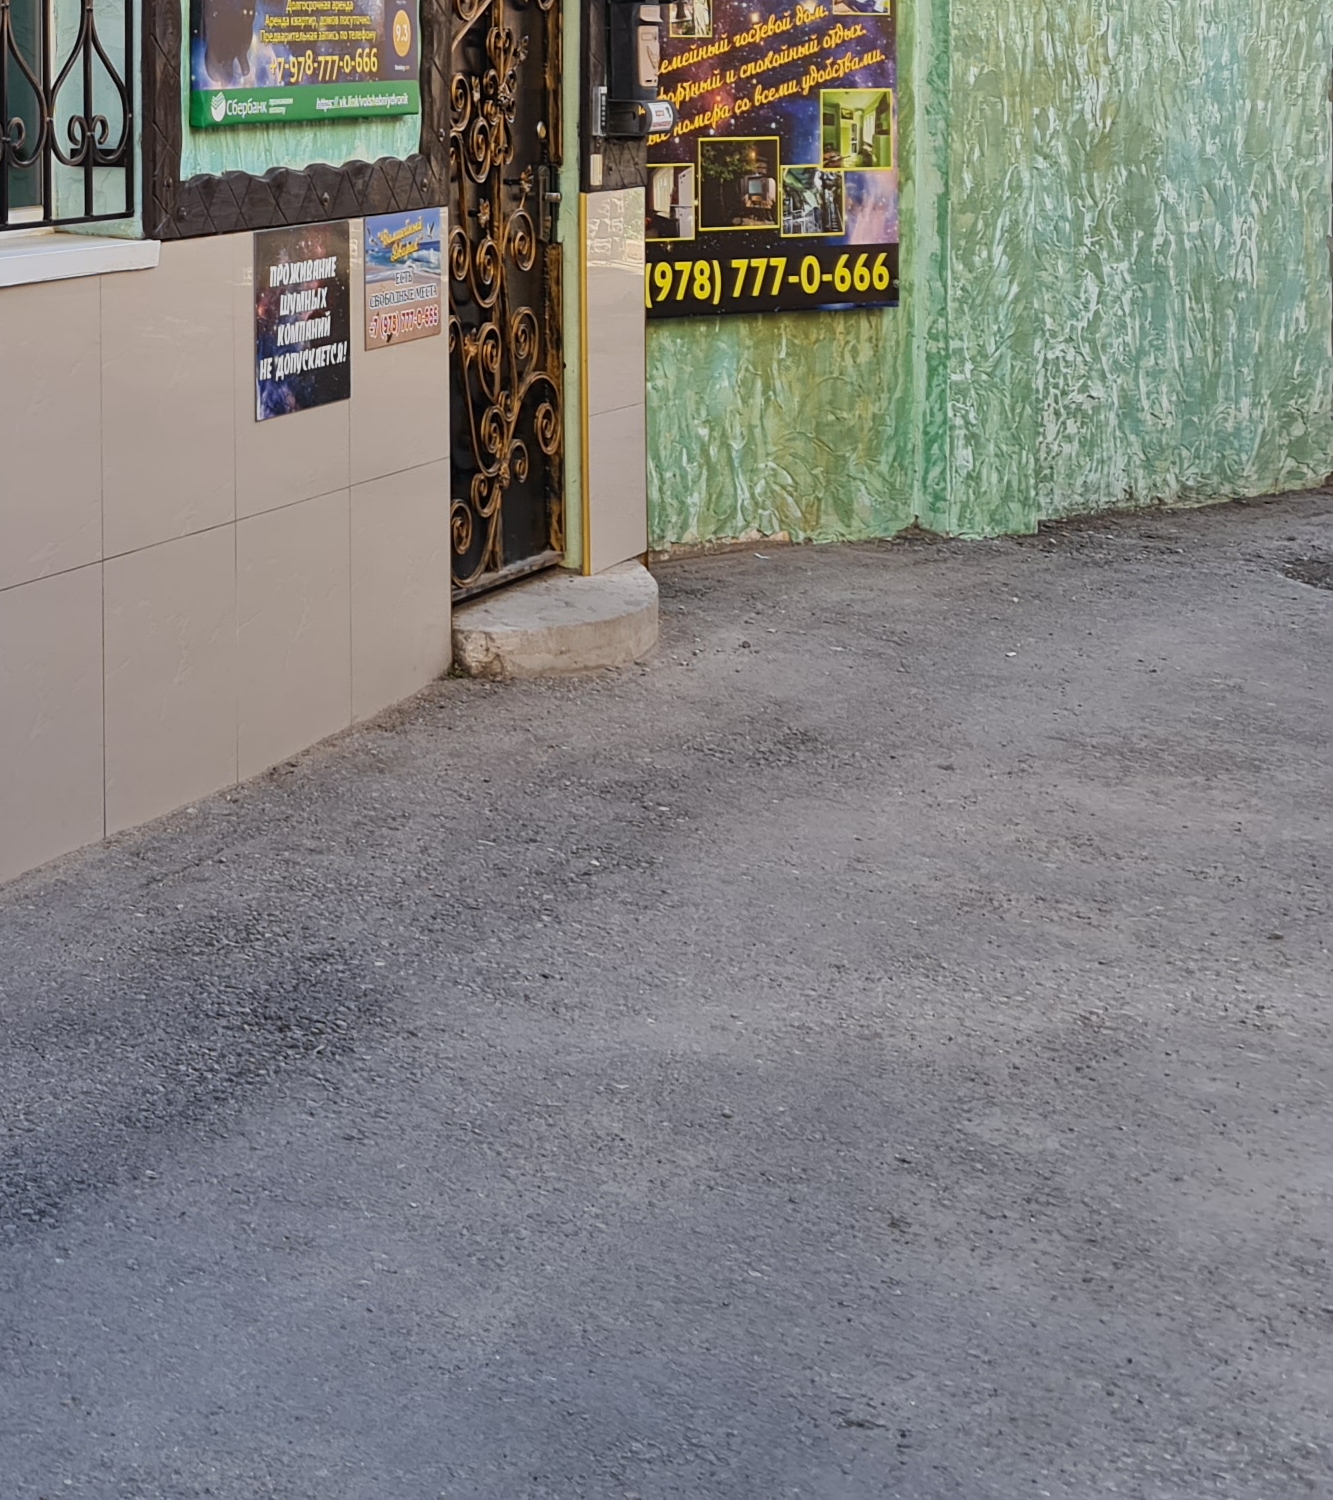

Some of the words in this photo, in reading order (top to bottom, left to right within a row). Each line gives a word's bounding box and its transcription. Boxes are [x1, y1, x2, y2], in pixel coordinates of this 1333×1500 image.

[270, 48, 378, 83] +7-978-777-0-666
[657, 33, 732, 76] емейный
[226, 98, 267, 118] Сбербанк
[269, 257, 337, 287] ПРОЖИВАНИЕ
[645, 260, 722, 308] (978)
[731, 252, 890, 298] 777-0-666
[279, 287, 328, 315] ШУМНЫХ
[277, 311, 331, 346] КОМПАНИЙ
[259, 360, 273, 380] НЕ
[274, 341, 348, 381] ДОПУСКАЕТСЯ!
